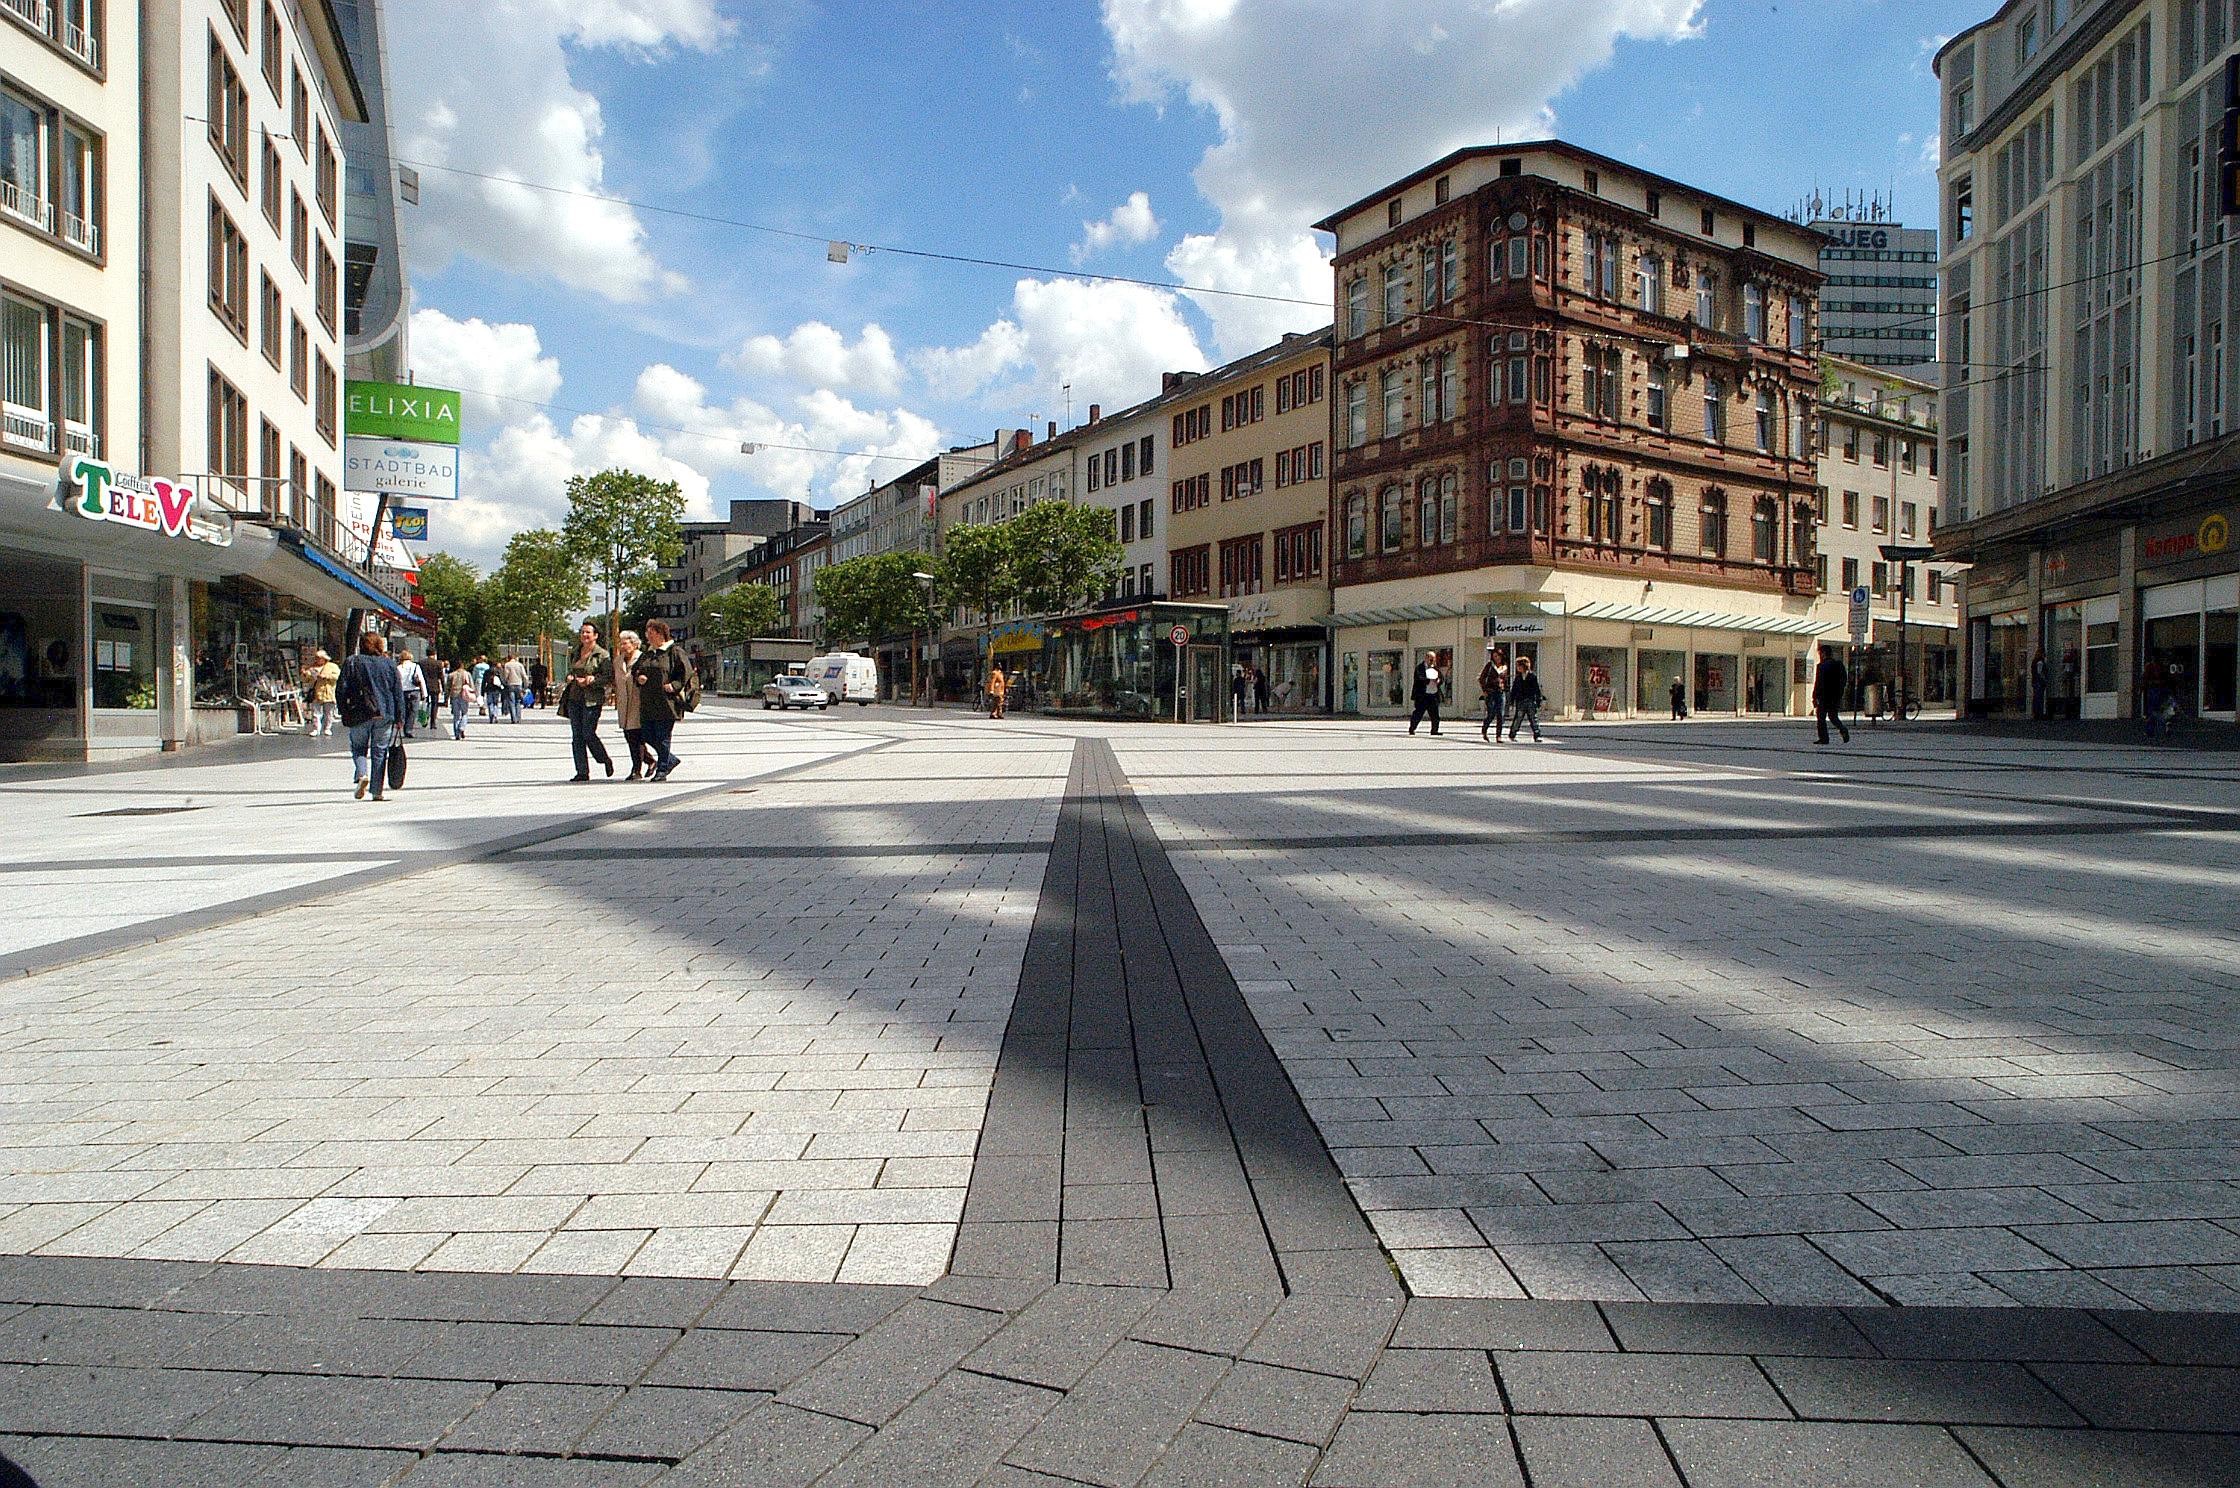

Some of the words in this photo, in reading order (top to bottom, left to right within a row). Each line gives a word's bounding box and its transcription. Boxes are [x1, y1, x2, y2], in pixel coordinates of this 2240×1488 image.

[349, 394, 454, 422] ELIXIA
[348, 457, 453, 478] STADTBAD
[375, 474, 427, 489] galerie
[75, 462, 192, 531] TELEV
[352, 520, 393, 542] PRIS
[1175, 630, 1185, 640] 20
